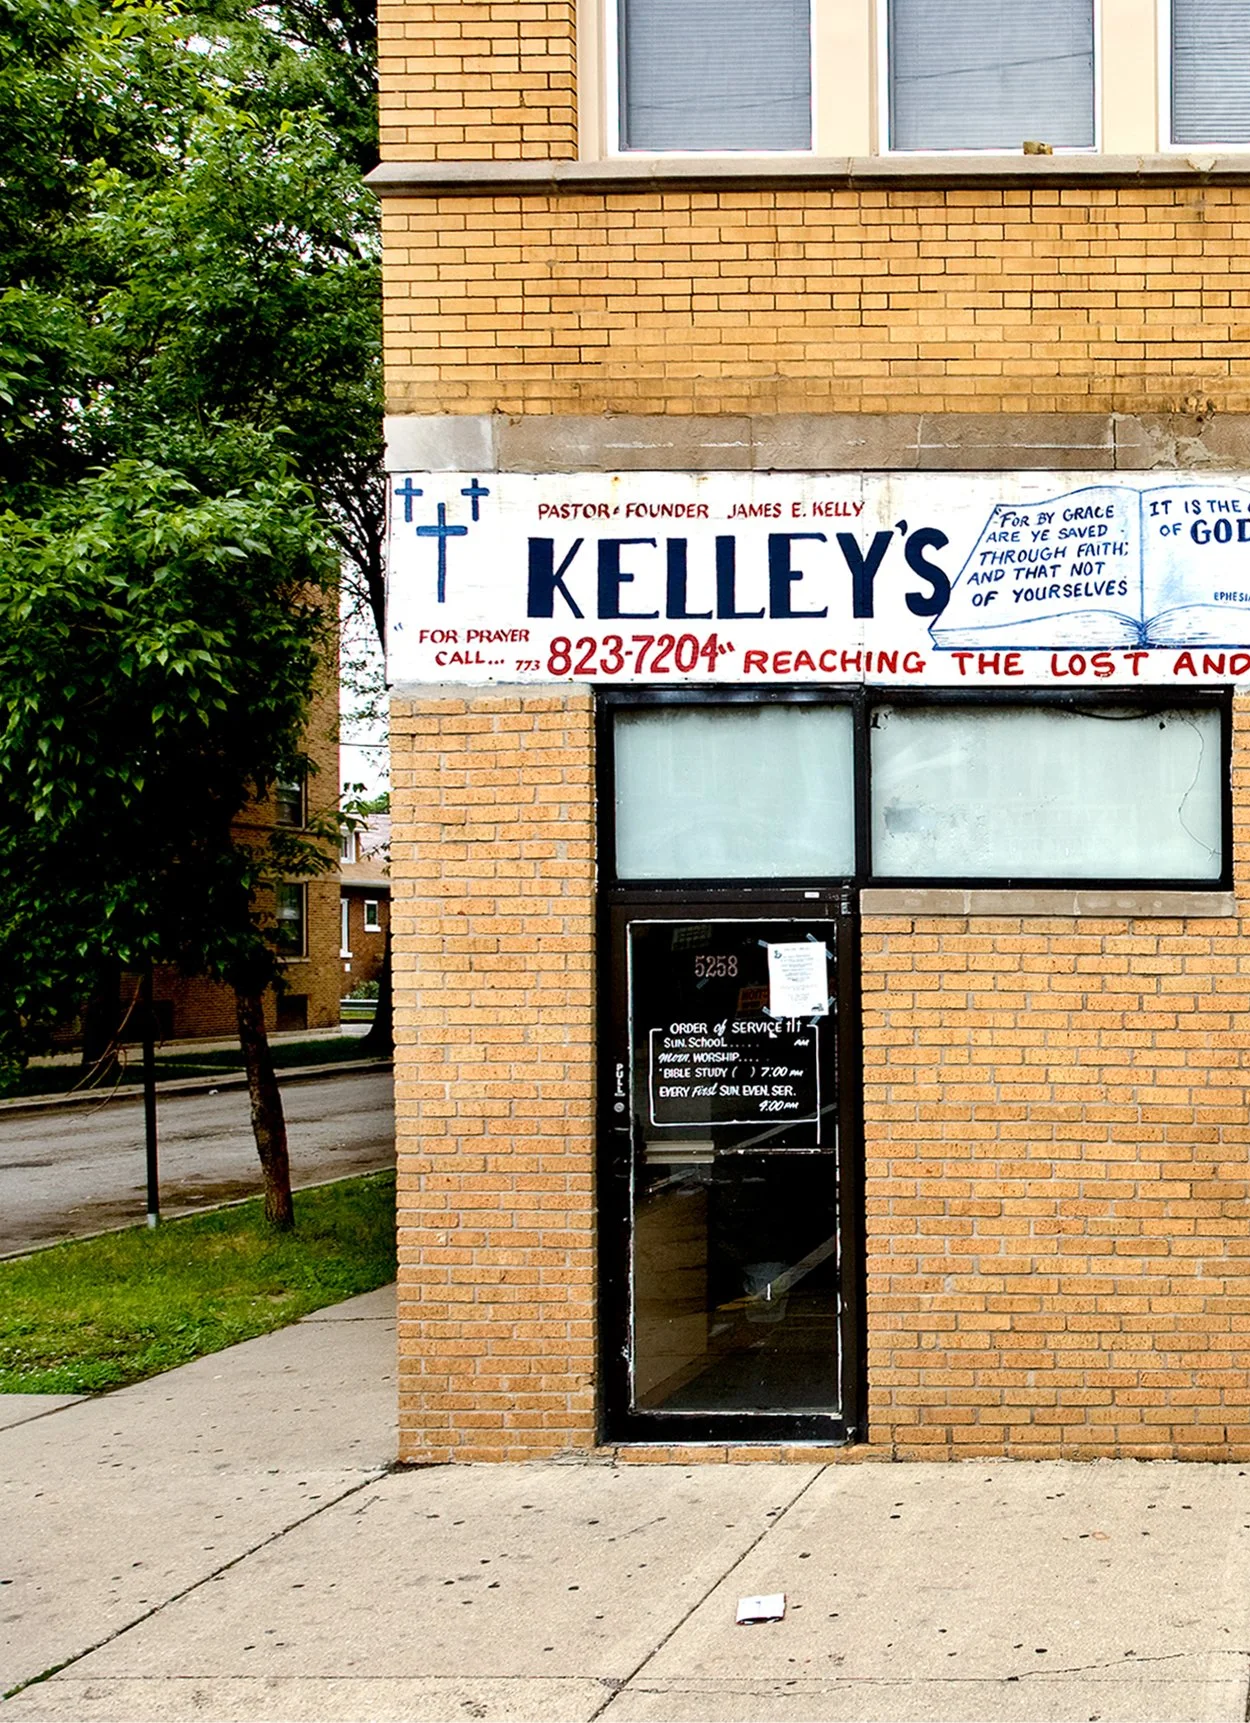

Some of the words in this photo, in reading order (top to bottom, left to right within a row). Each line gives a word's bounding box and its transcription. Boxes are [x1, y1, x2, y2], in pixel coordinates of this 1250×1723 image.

[538, 503, 611, 519] PASTOR
[626, 503, 709, 519] FOUNDER
[727, 502, 782, 520] JAMES
[791, 503, 807, 518] E.
[812, 501, 866, 518] KELLY
[1036, 512, 1055, 526] BY
[1062, 505, 1114, 522] GRACE
[1149, 500, 1172, 516] IT
[1185, 500, 1201, 515] IS
[1207, 500, 1242, 513] THE
[986, 531, 1020, 543] ARE
[1031, 529, 1050, 543] YE
[1058, 524, 1108, 540] SAVED
[1160, 523, 1182, 536] OF
[980, 546, 1067, 566] THROUGH
[528, 520, 951, 619] KELLEY'S
[967, 569, 1005, 585] AND
[1014, 564, 1061, 580] THAT
[1070, 561, 1105, 577] NOT
[972, 590, 998, 607] OF
[1013, 580, 1128, 603] YOURSELVES
[419, 629, 457, 644] FOR
[466, 629, 530, 643] PRAYER
[515, 659, 540, 672] 773
[547, 633, 718, 676] 823-7204
[951, 652, 1024, 675] THE
[1051, 652, 1149, 677] LOST
[694, 955, 738, 977] 5258
[670, 1023, 708, 1034] ORDER
[713, 1019, 727, 1036] of
[731, 1021, 782, 1034] SERVICE
[664, 1037, 687, 1048] SUN.
[615, 1063, 625, 1095] PULL
[664, 1068, 691, 1078] BIBLE
[695, 1067, 728, 1078] STUDY
[761, 1066, 788, 1077] 7:00
[660, 1086, 690, 1097] EVERY
[742, 1085, 769, 1096] EVEN.
[771, 1085, 796, 1096] SER.
